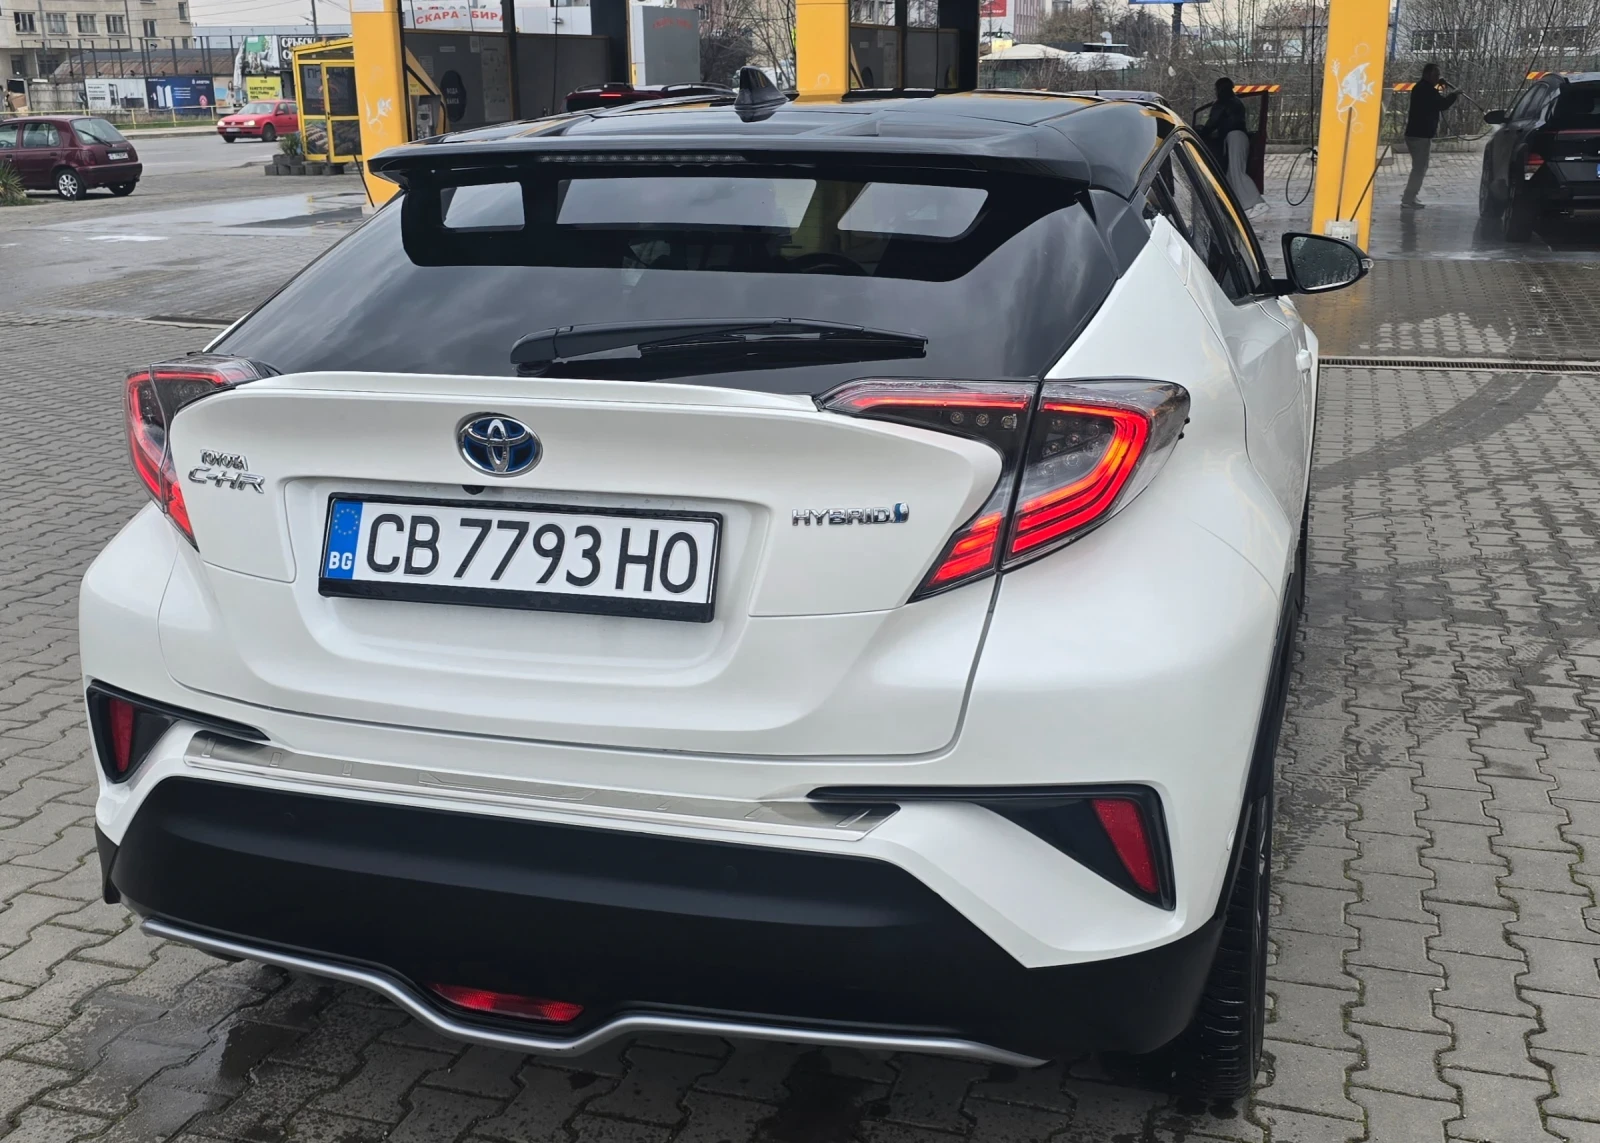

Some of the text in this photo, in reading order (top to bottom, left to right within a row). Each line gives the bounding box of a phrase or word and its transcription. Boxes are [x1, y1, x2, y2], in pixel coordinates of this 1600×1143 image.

[415, 11, 459, 25] СКАРА
[200, 449, 248, 471] TOYOTA
[188, 466, 264, 494] C-HR
[792, 507, 890, 526] HYBRID
[329, 551, 353, 571] BG
[366, 513, 440, 577] CB
[454, 517, 602, 588] 7793
